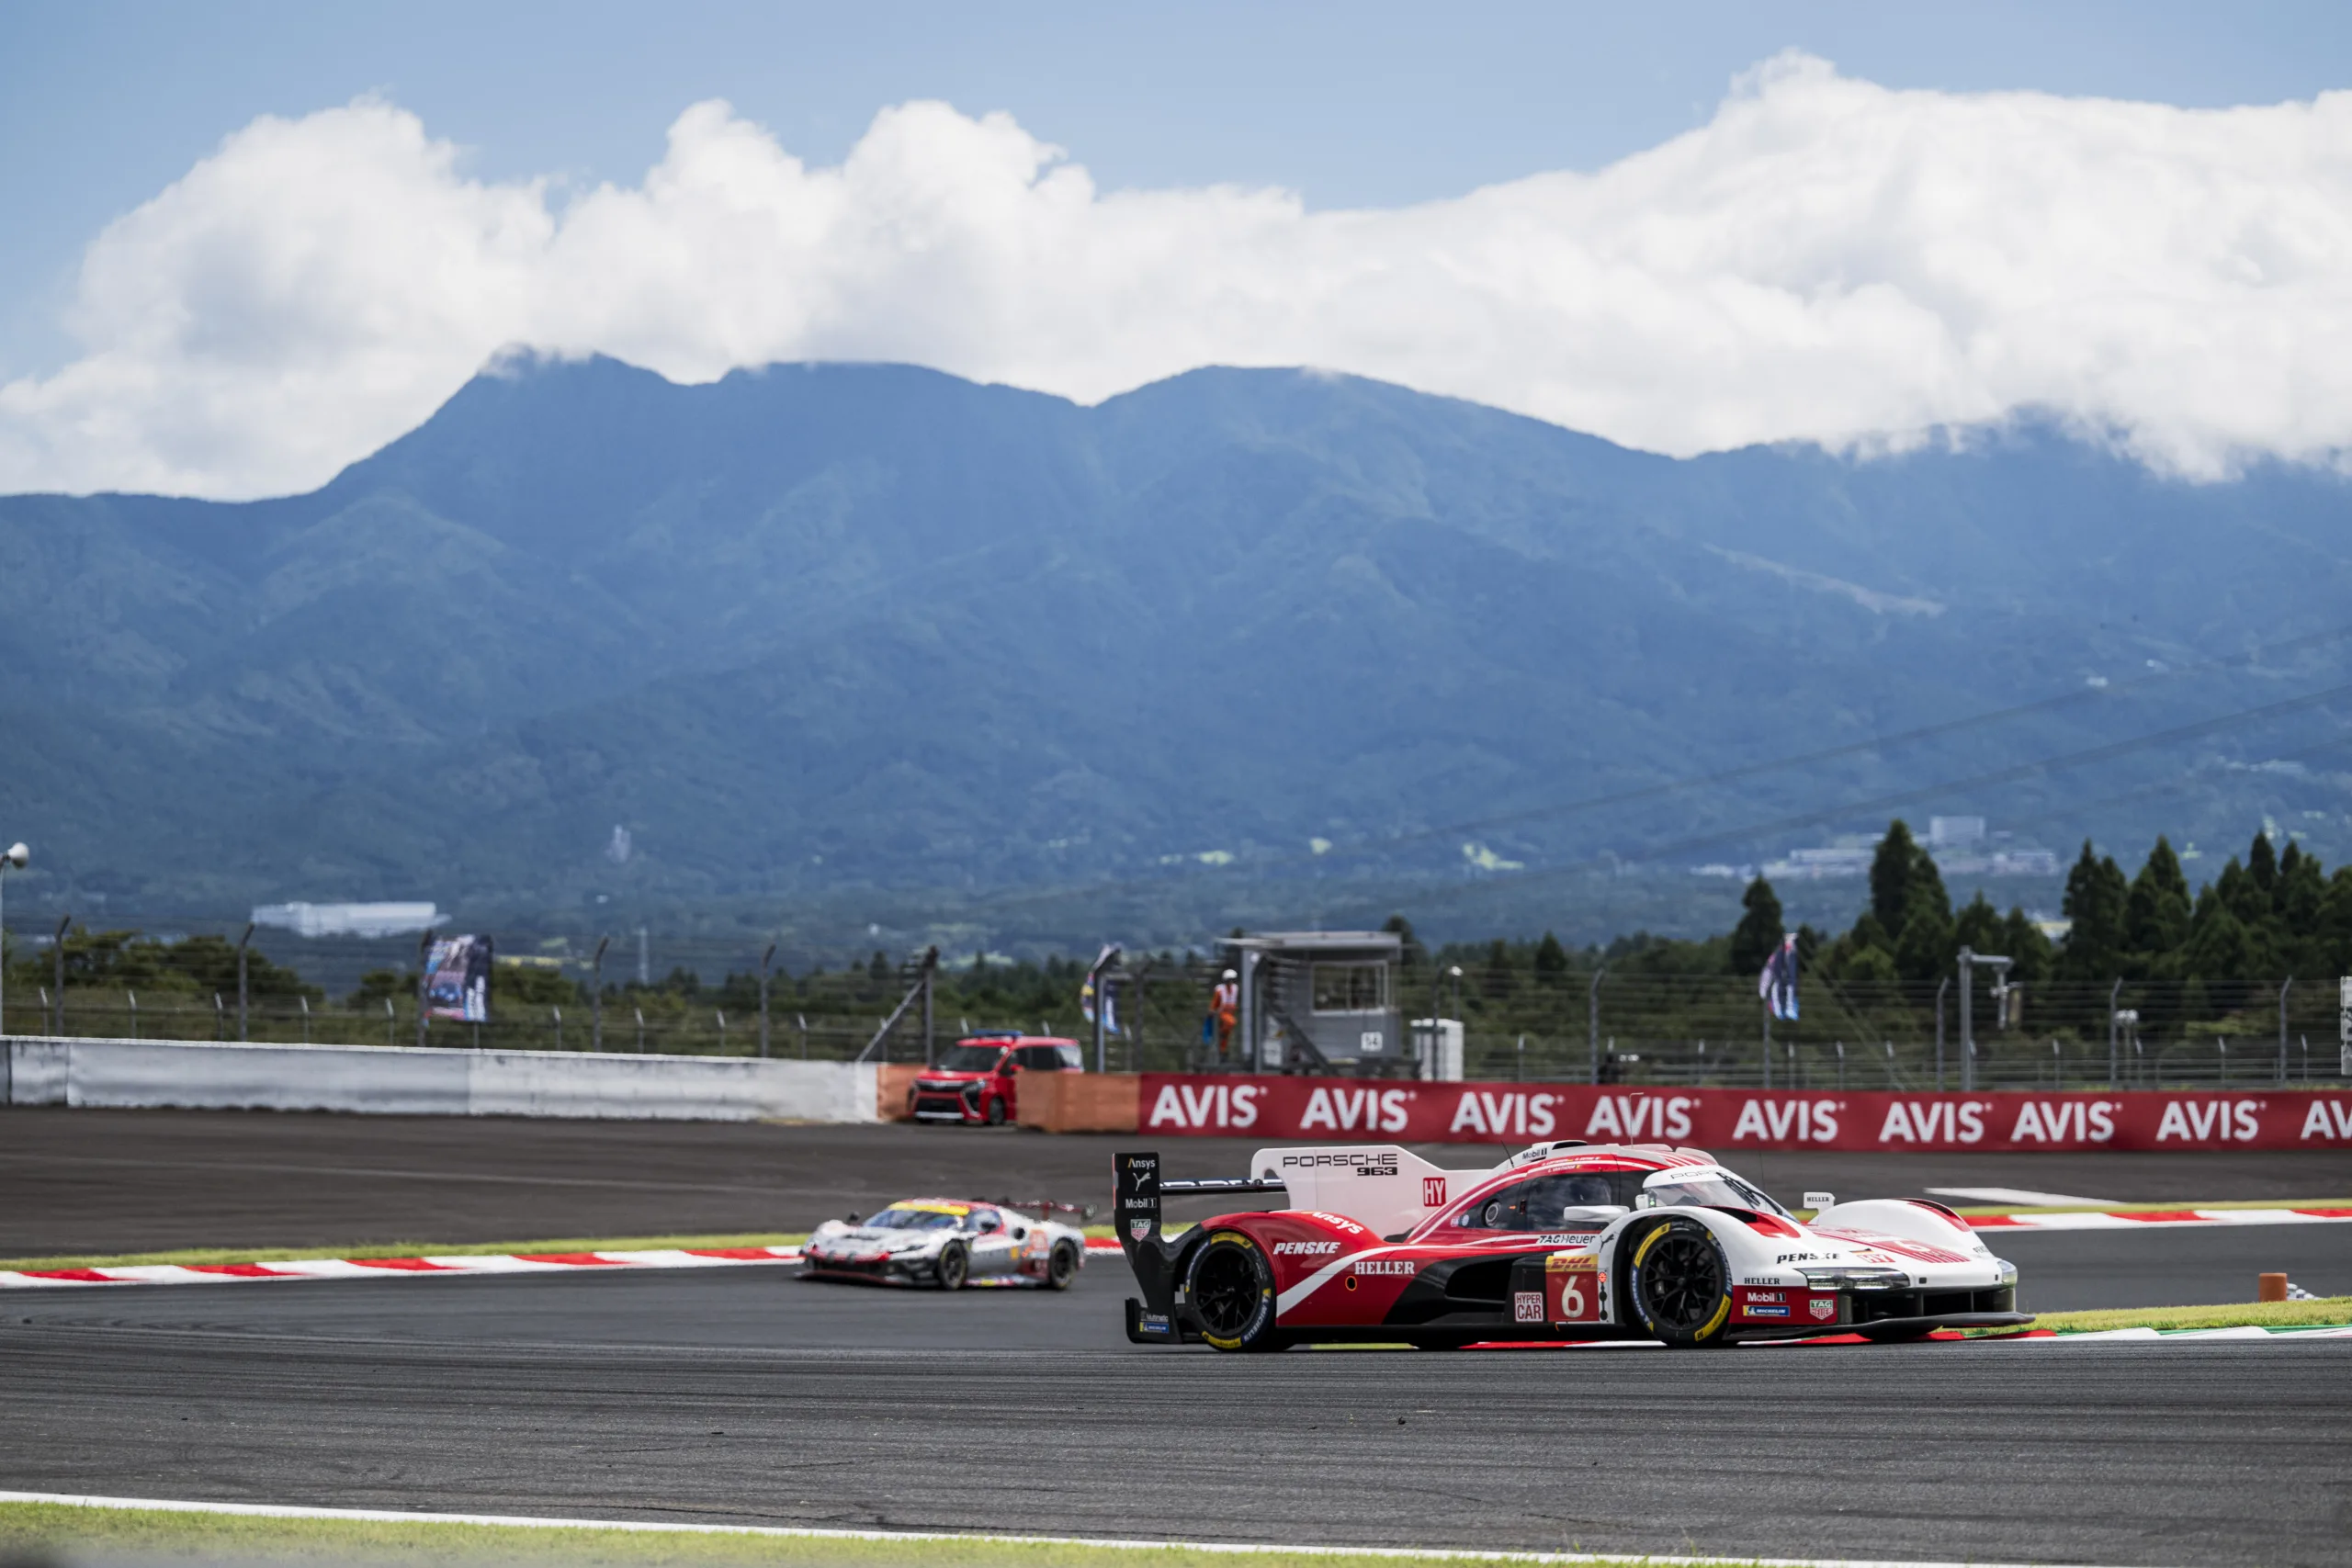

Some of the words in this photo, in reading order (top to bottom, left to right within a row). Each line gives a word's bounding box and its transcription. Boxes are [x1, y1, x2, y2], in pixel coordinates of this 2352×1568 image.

[1149, 1085, 1259, 1128] AVIS
[1299, 1088, 1408, 1132] AVIS
[1450, 1091, 1556, 1136] AVIS
[1585, 1096, 1692, 1139] AVIS
[1732, 1100, 1839, 1142] AVIS
[1878, 1101, 1984, 1143] AVIS
[2010, 1100, 2115, 1142] AVIS
[2155, 1100, 2259, 1141] AVIS
[1283, 1154, 1397, 1168] PORSCHE
[1522, 1149, 1540, 1159] Mobil
[1127, 1157, 1156, 1170] Ansys
[1357, 1167, 1397, 1176] 963
[1425, 1179, 1444, 1202] HY
[1125, 1198, 1148, 1209] Mobil
[1272, 1241, 1341, 1256] PENSKE
[1354, 1260, 1416, 1275] HELLER
[1551, 1257, 1594, 1269] DHL
[1744, 1277, 1781, 1285] HELLER
[1516, 1293, 1542, 1304] HYPER
[1561, 1274, 1585, 1318] 6
[1747, 1292, 1775, 1303] Mobil
[1517, 1304, 1542, 1320] CAR
[1811, 1308, 1832, 1319] HEUER
